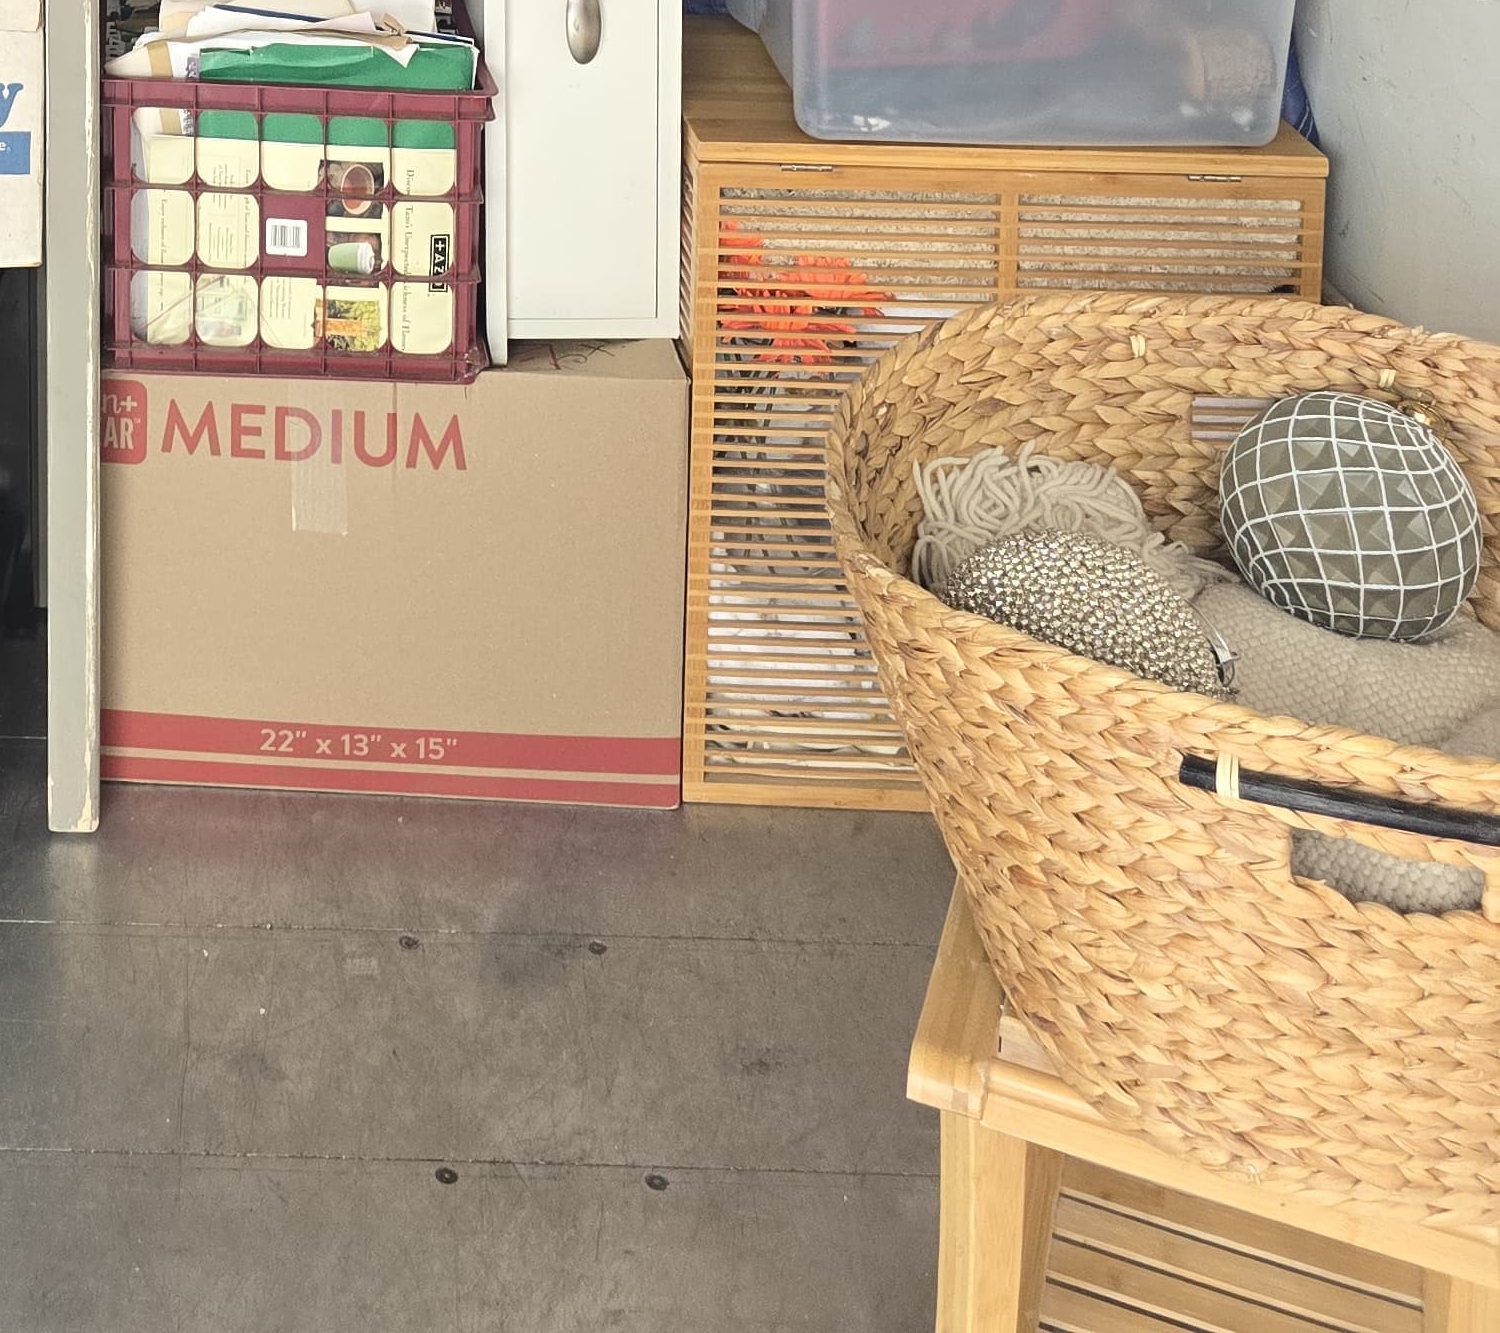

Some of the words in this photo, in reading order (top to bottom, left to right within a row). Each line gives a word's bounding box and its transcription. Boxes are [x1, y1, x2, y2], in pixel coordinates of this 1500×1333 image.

[160, 398, 468, 471] MEDIUM
[260, 728, 307, 753] 22"
[315, 738, 332, 755] x
[340, 733, 382, 756] 13"
[390, 741, 407, 758] x
[415, 737, 457, 760] 15"
